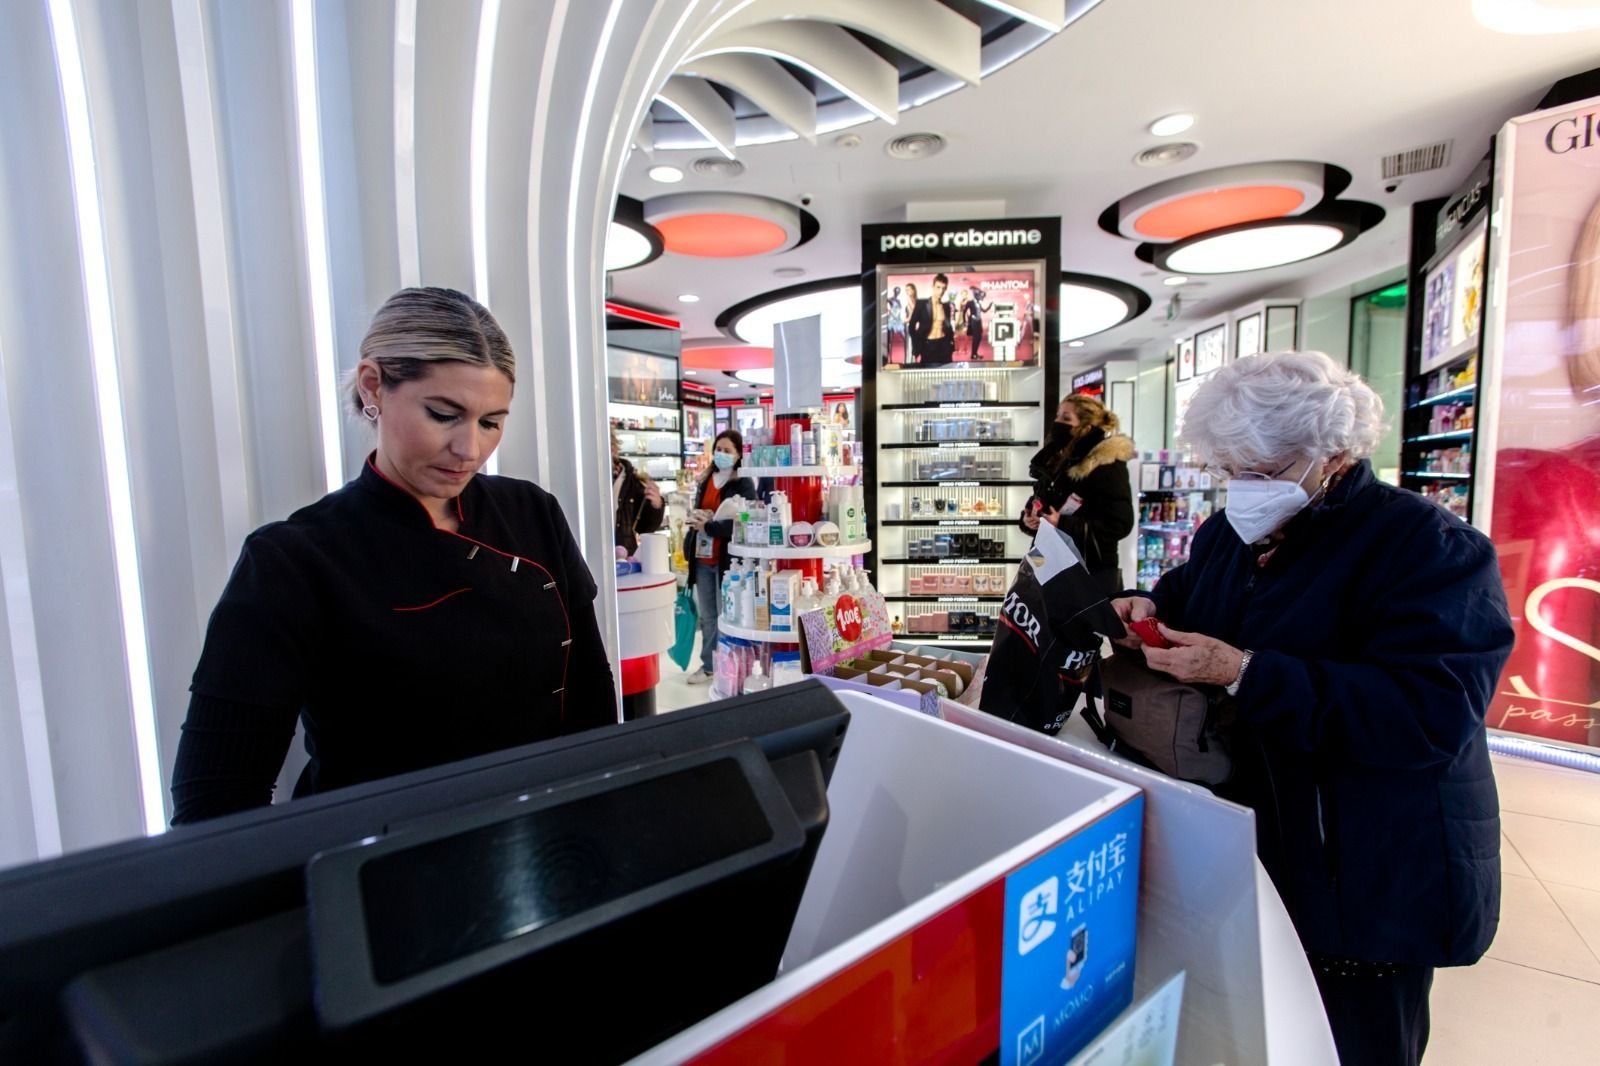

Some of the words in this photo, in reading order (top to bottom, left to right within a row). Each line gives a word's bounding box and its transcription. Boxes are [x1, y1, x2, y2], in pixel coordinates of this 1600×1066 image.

[1545, 112, 1600, 155] GI
[880, 233, 940, 252] paco
[942, 228, 1042, 247] rabanne
[981, 280, 1029, 290] PHANTOM
[1064, 832, 1127, 905] 支付宝
[1065, 868, 1124, 923] ALIPAY
